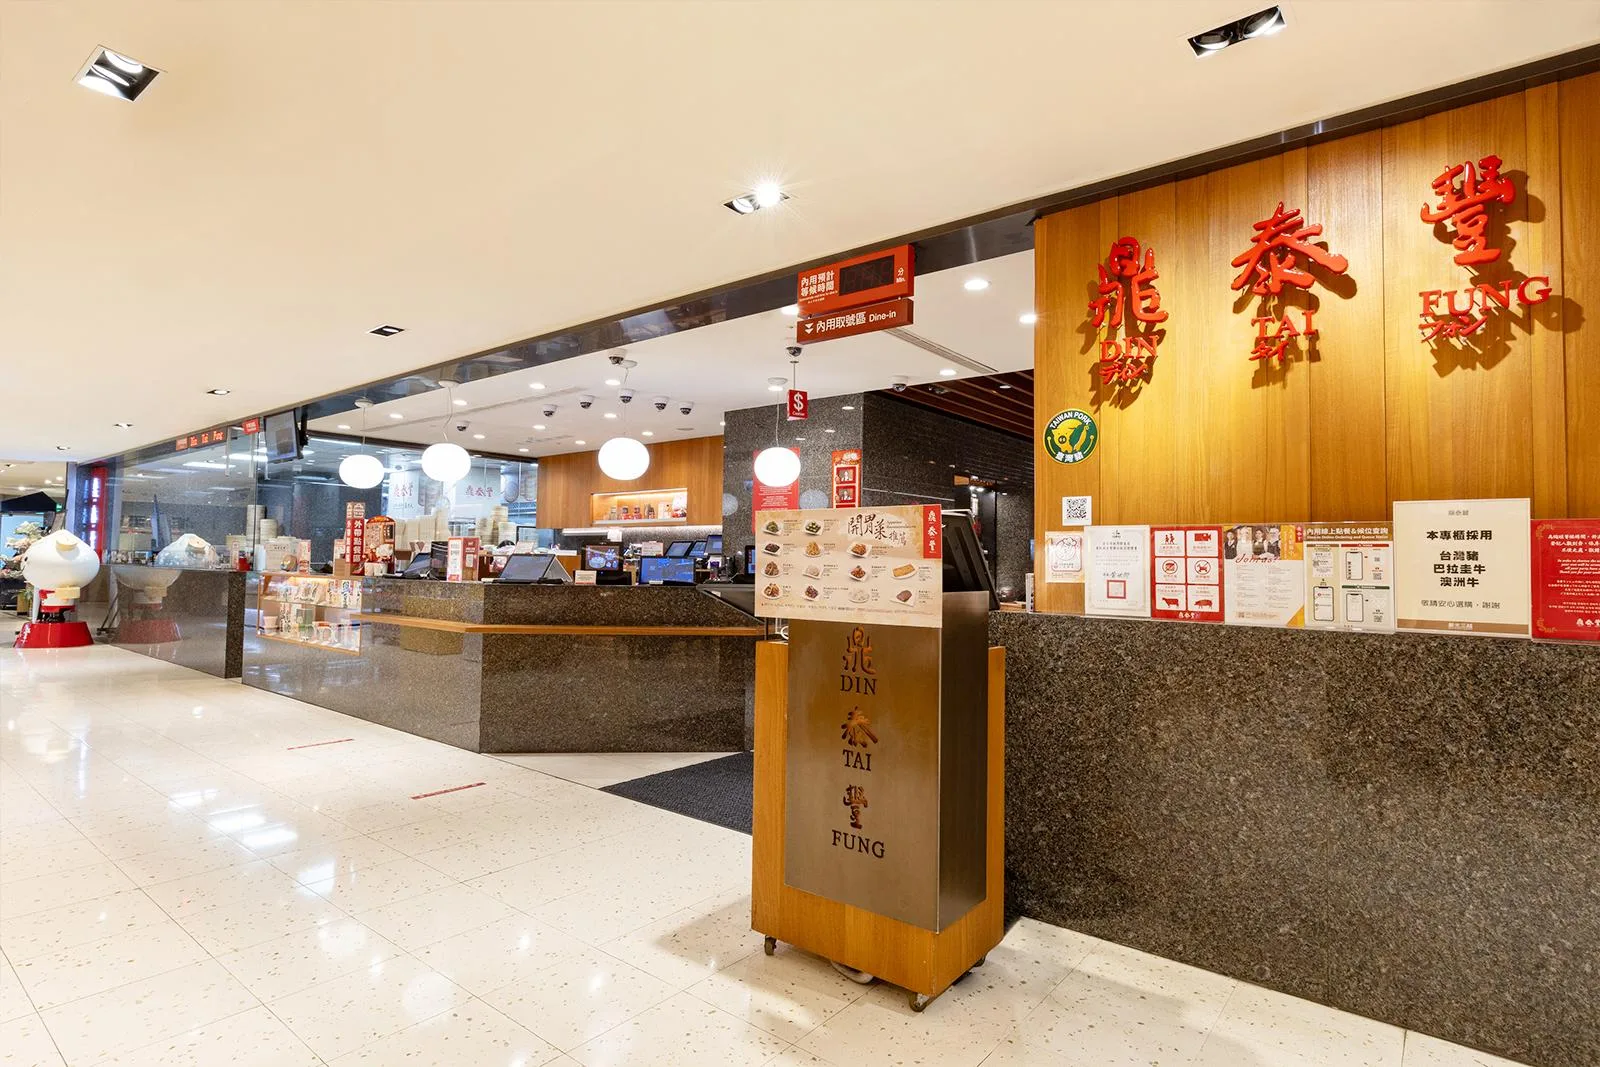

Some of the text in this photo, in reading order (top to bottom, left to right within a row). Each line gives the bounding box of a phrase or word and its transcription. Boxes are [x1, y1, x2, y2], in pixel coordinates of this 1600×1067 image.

[1421, 154, 1515, 266] 豐
[1231, 201, 1348, 297] 泰
[897, 267, 904, 276] 分
[1419, 275, 1552, 317] FUNG
[869, 310, 896, 322] Dine-in
[1251, 309, 1316, 339] TAI
[1101, 334, 1158, 363] DIN
[1050, 412, 1091, 429] TAIWAN PORK
[1426, 530, 1493, 540] 本專櫃採用
[1440, 551, 1479, 561] 台灣豬
[1433, 564, 1486, 574] 巴拉圭牛
[1440, 577, 1480, 587] 澳洲牛
[840, 674, 877, 695] DIN
[842, 749, 872, 772] TAI
[831, 829, 885, 859] FUNG
